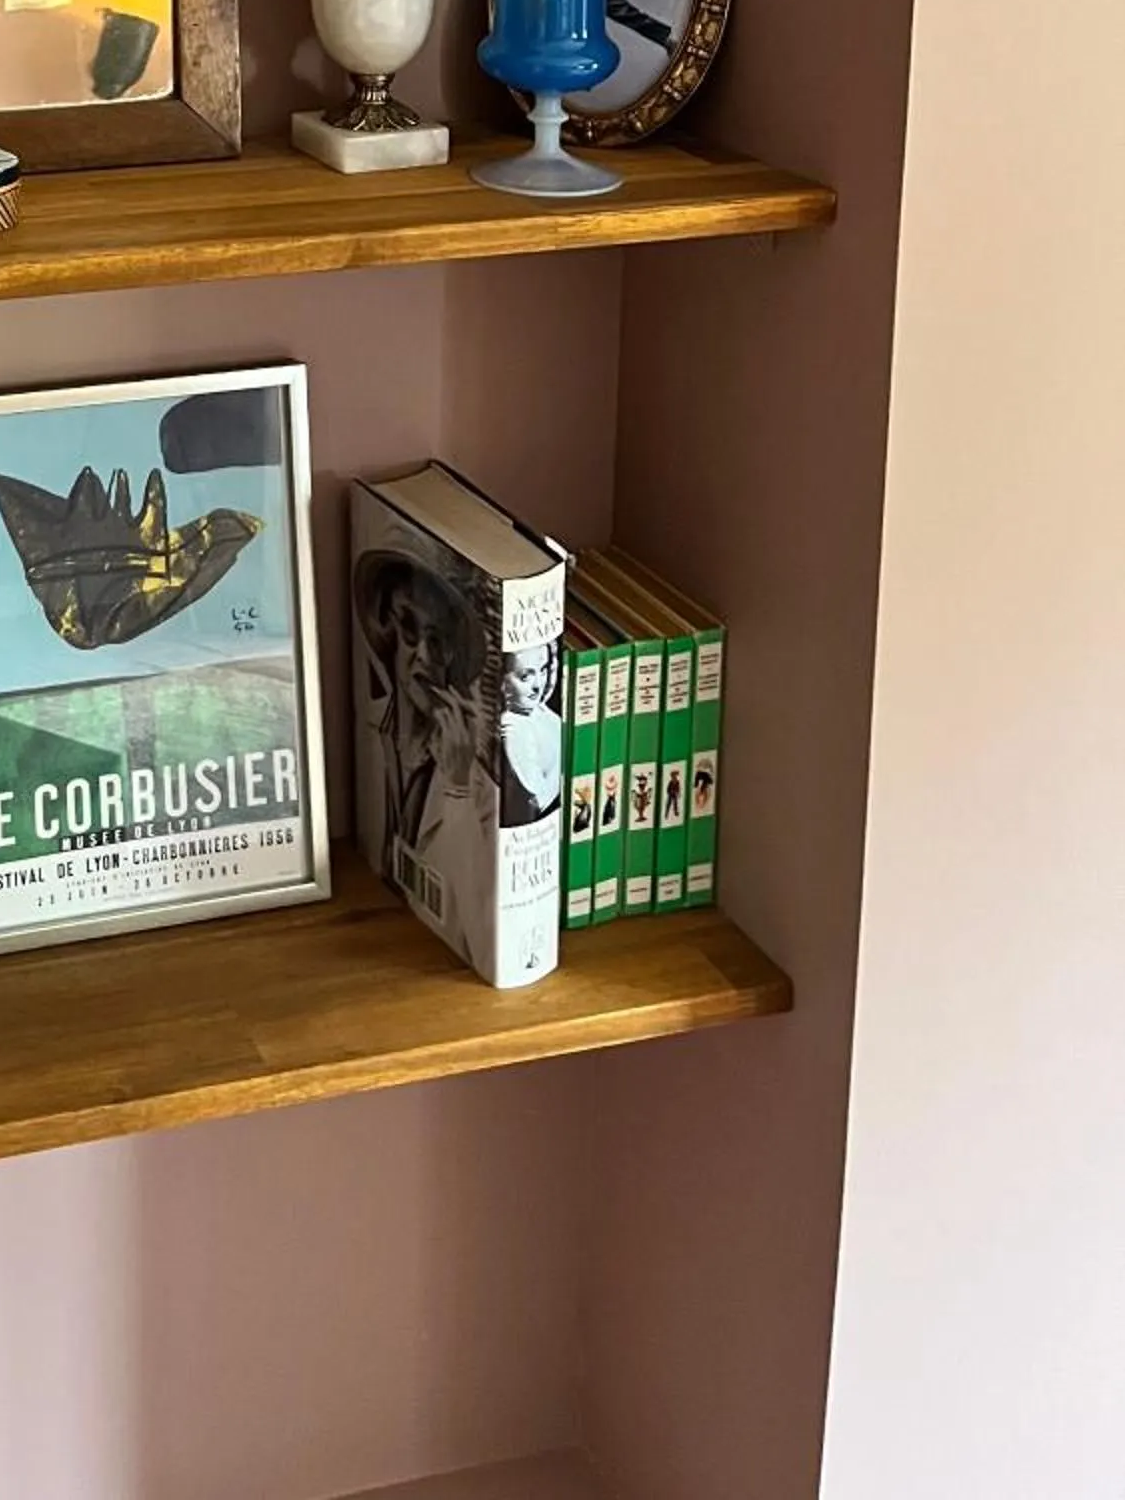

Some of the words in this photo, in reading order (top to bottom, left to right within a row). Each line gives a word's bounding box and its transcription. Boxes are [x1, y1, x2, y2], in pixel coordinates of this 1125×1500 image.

[34, 747, 300, 839] CORBUSIER
[56, 861, 74, 879] DE
[259, 828, 294, 848] 1956
[134, 823, 155, 839] DE
